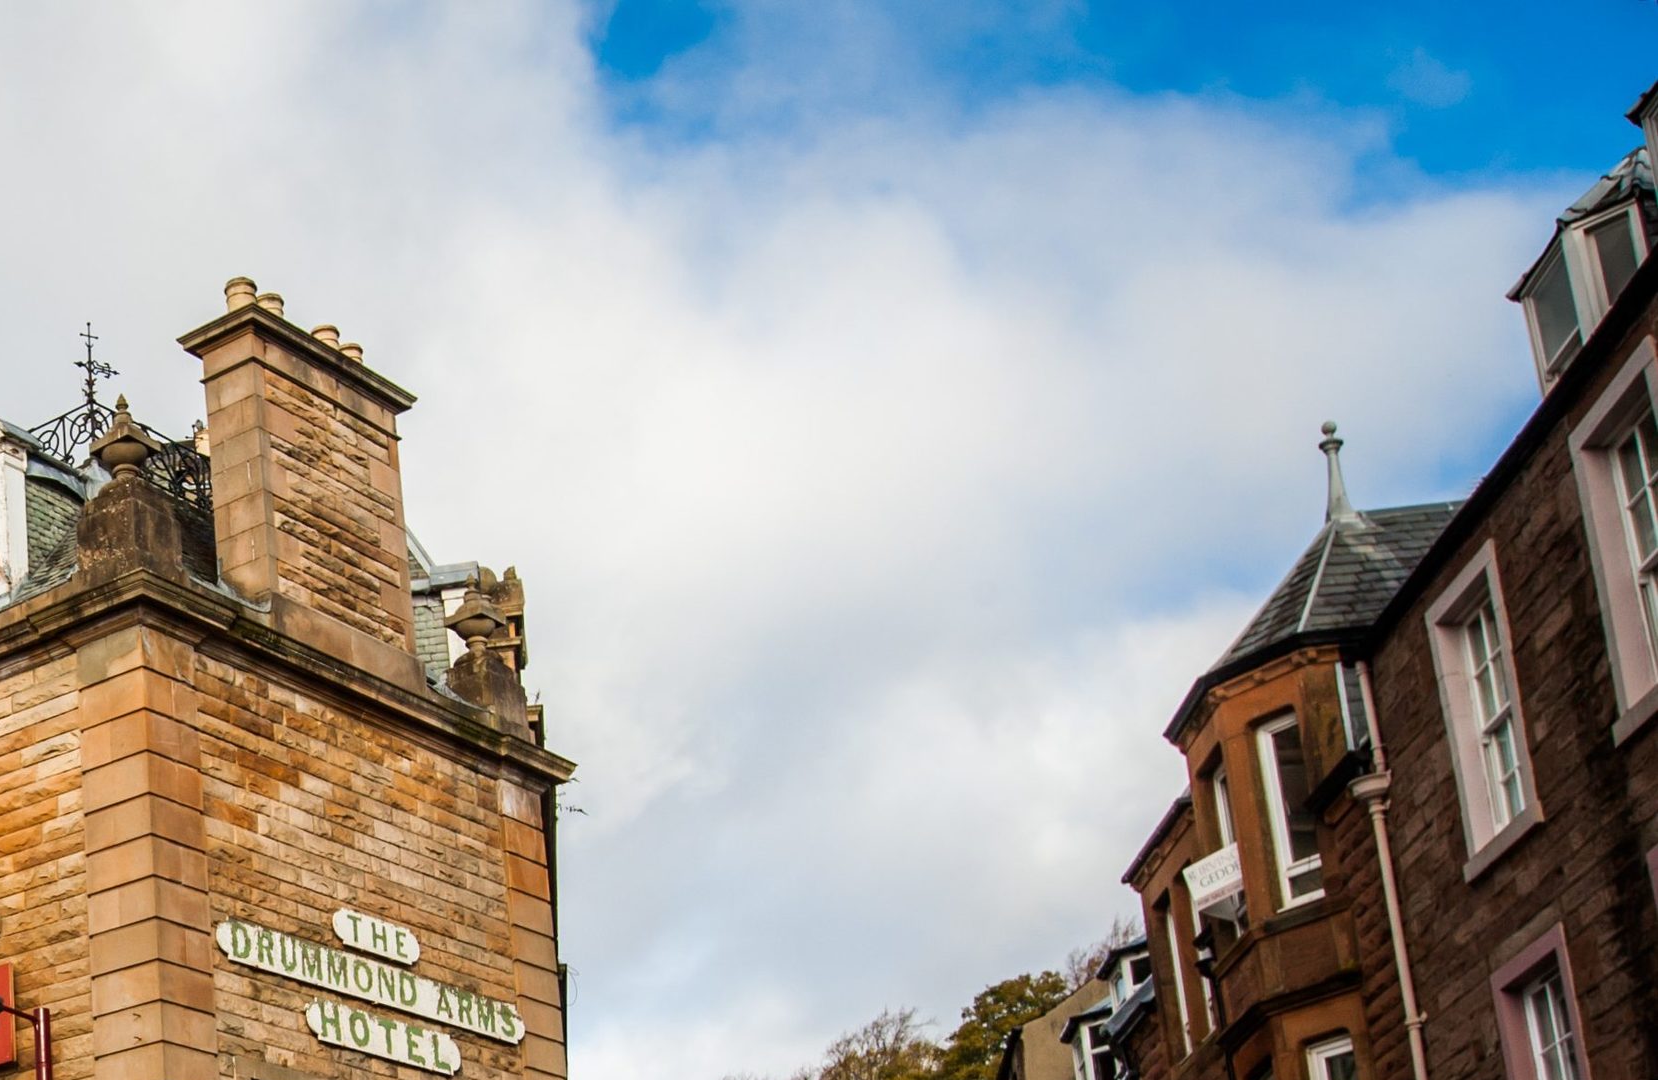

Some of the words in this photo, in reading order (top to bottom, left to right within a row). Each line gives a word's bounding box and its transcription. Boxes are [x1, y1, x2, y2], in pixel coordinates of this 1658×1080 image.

[347, 914, 408, 959] THE
[231, 921, 417, 1006] DRUMMOND
[437, 986, 516, 1038] ARMS
[320, 1000, 452, 1074] HOTEL
